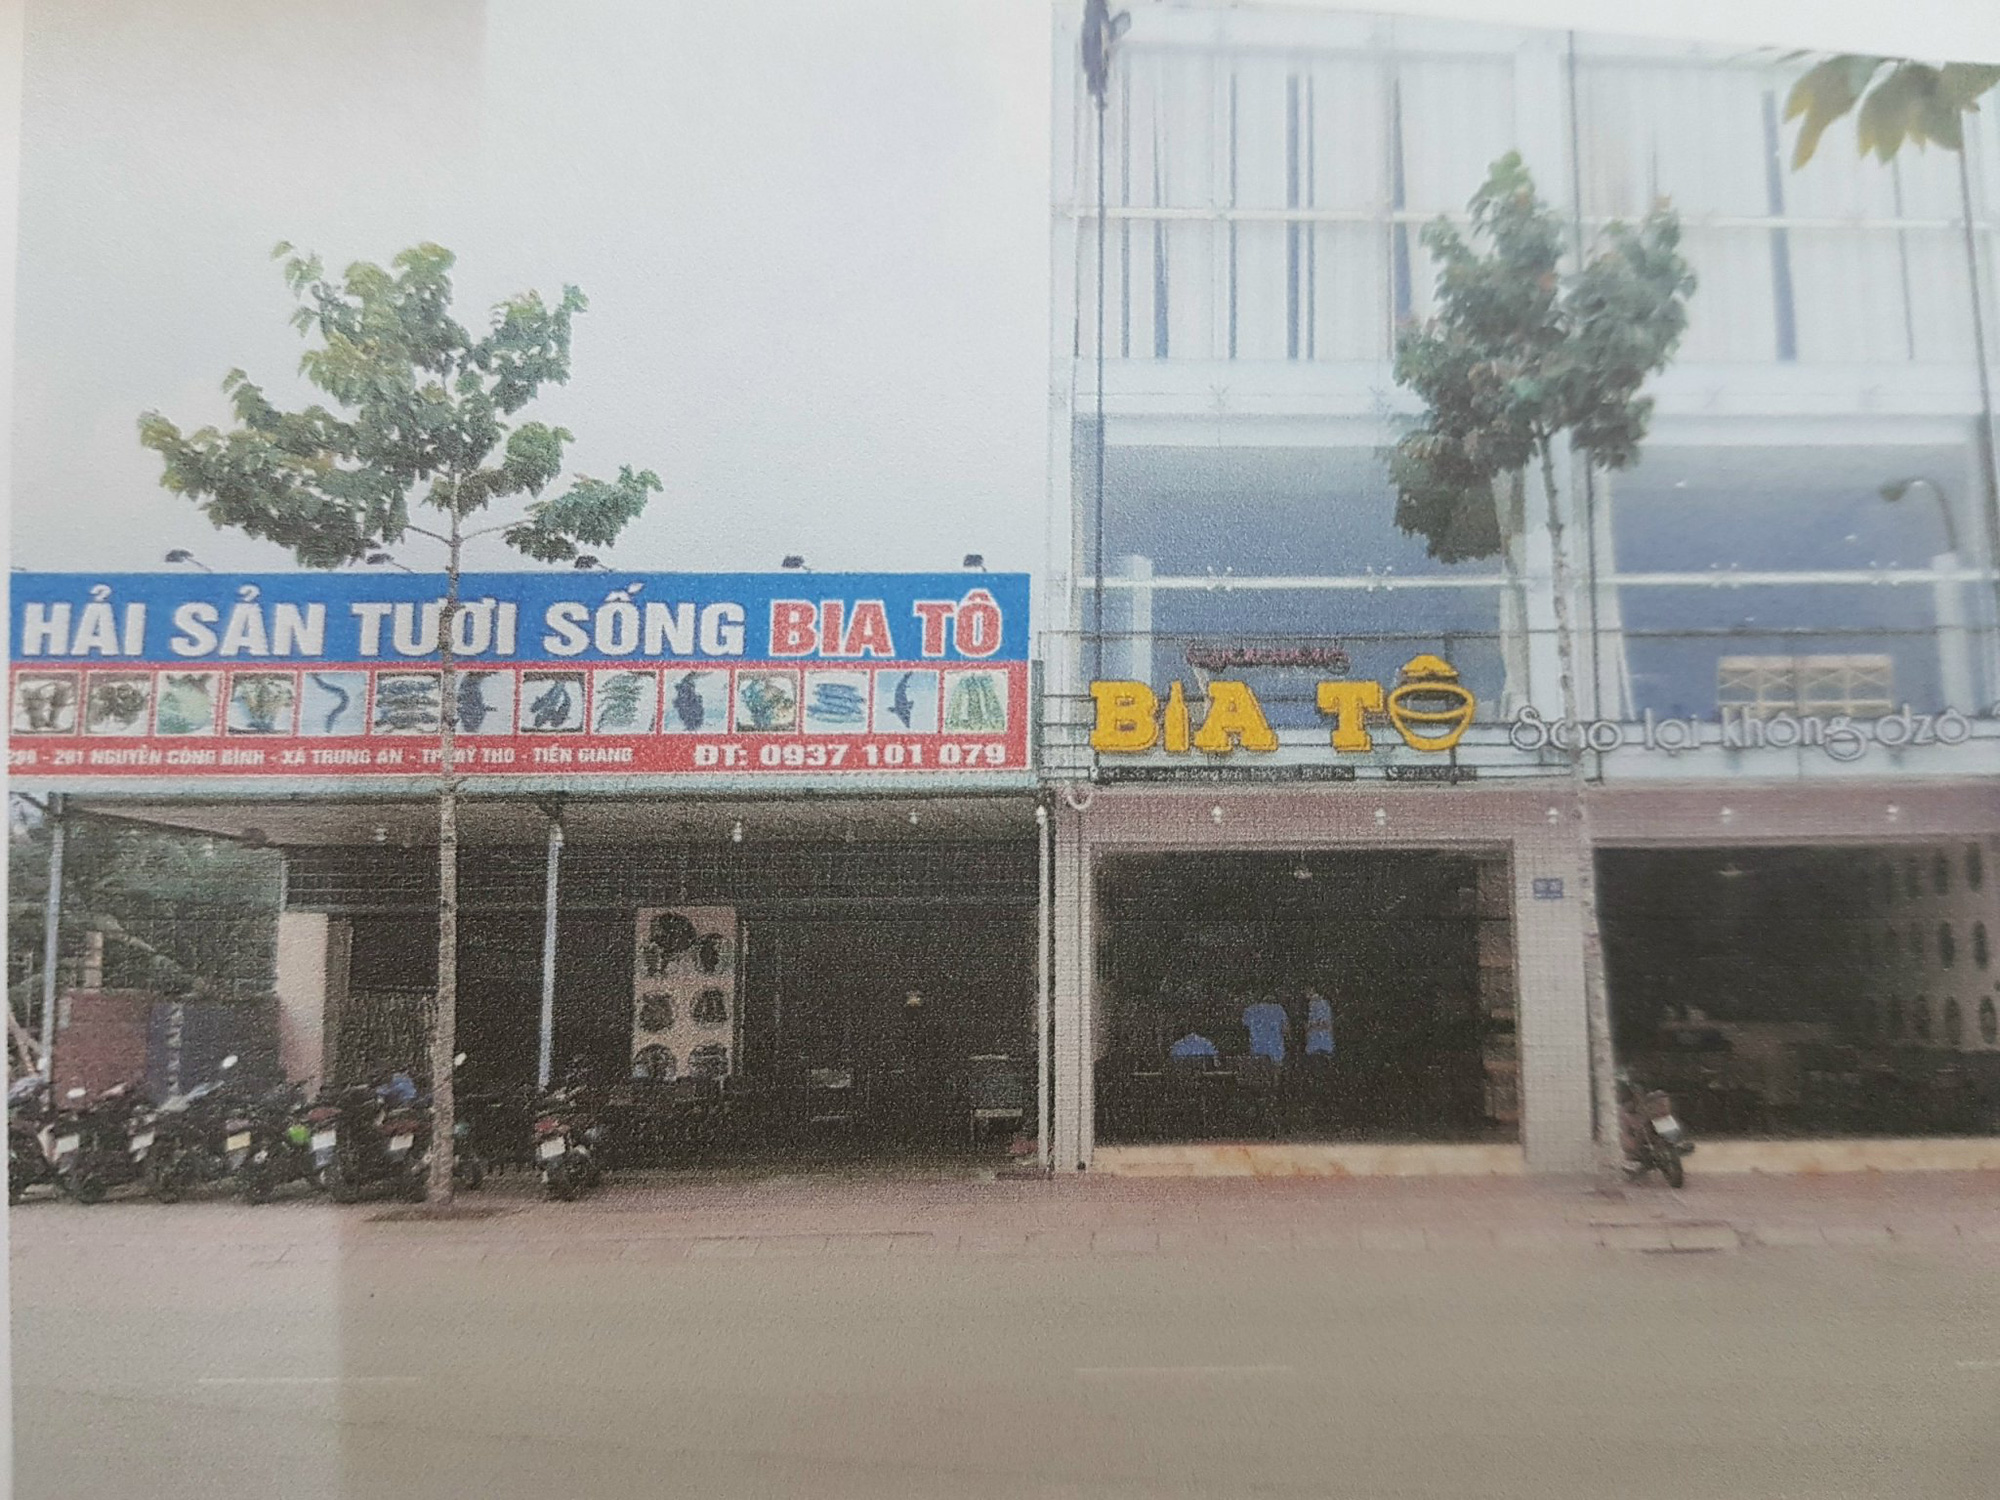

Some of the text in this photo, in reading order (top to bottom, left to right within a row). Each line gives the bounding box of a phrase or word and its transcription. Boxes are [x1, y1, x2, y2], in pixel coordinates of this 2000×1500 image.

[22, 584, 146, 657] HẢI
[171, 584, 326, 657] SẢN
[544, 583, 745, 656] SỐNG
[769, 598, 896, 657] BIA
[914, 587, 1003, 658] TÔ
[1088, 681, 1278, 752] BIA
[1510, 706, 1621, 752] Sao
[1722, 706, 1866, 761] không
[1874, 703, 1971, 745] dzô
[759, 743, 849, 766] 0937
[863, 744, 923, 765] 101
[939, 743, 1007, 765] 079
